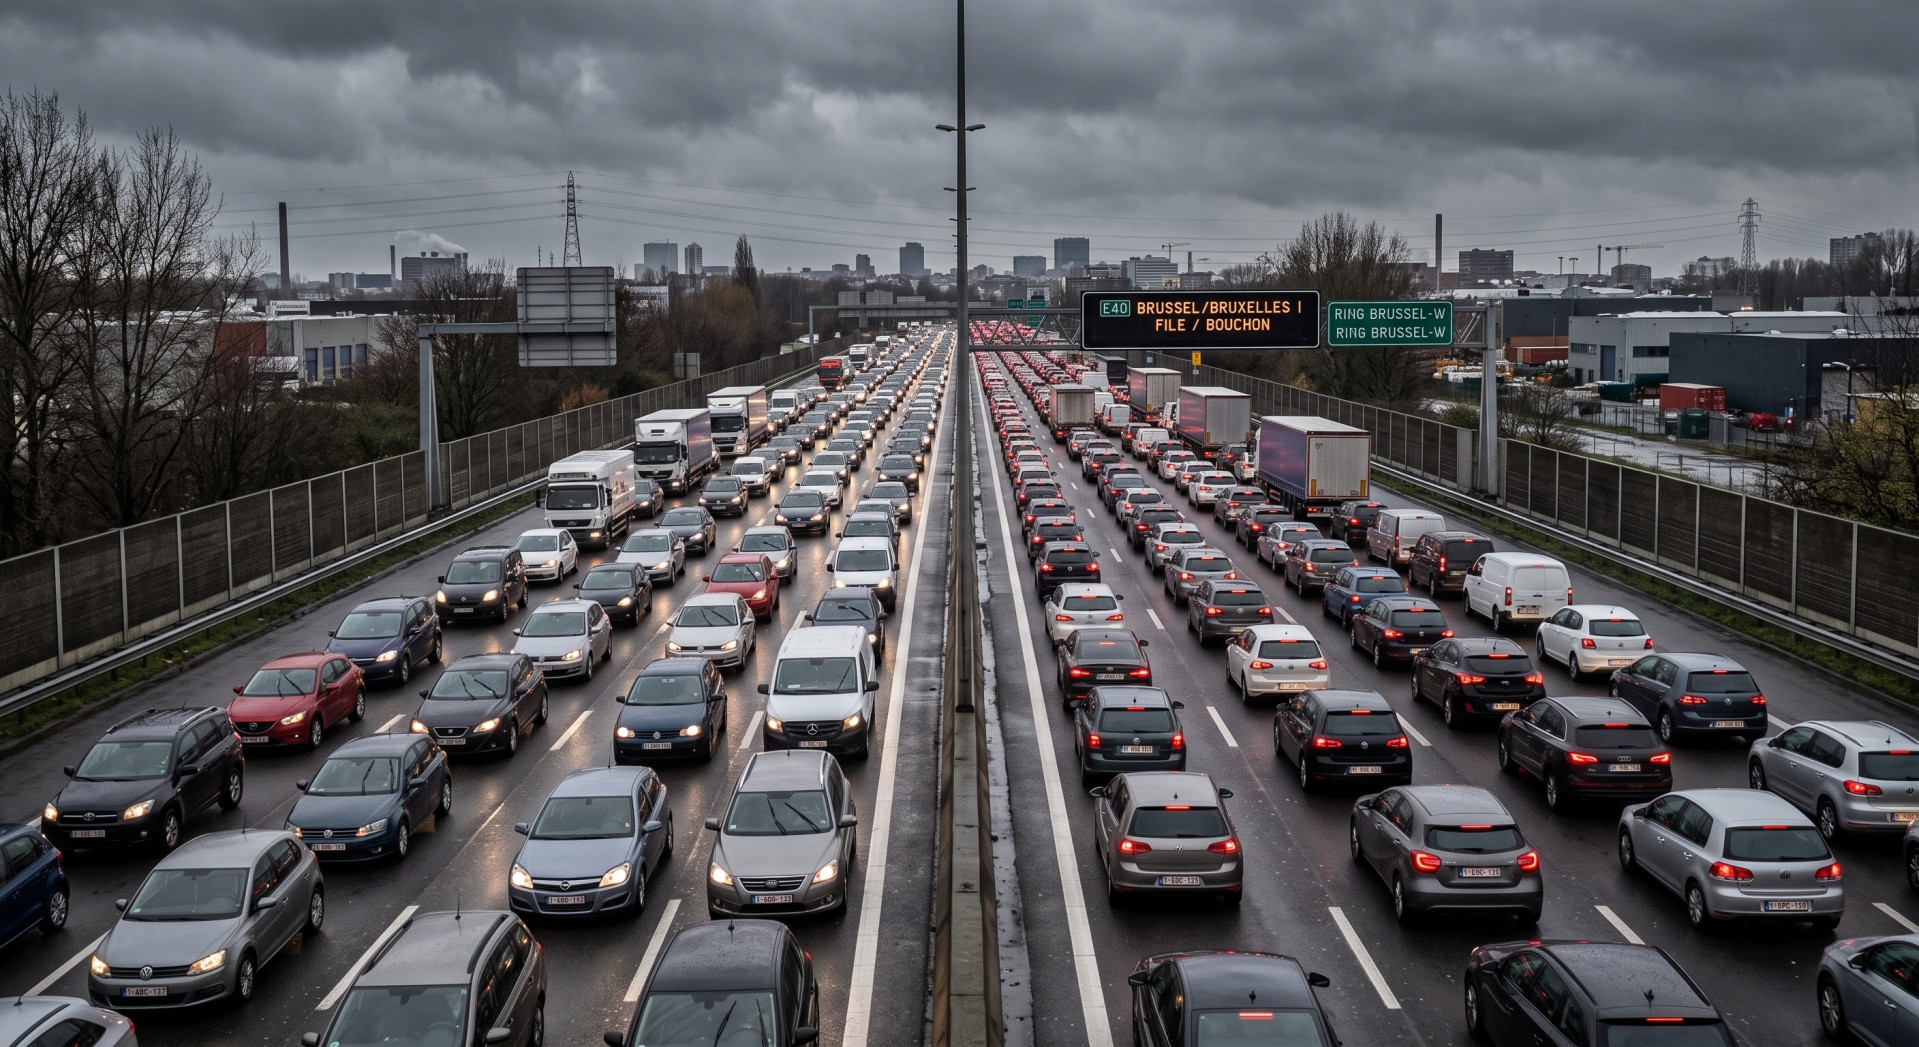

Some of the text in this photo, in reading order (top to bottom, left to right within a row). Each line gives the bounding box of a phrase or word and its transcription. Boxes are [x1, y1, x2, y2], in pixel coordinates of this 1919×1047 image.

[1103, 302, 1128, 314] E40
[1137, 301, 1291, 314] BRUSSEL/BRUXELLES
[1334, 307, 1446, 320] RING BRUSSEL-W
[1155, 318, 1270, 331] FILE / BOUCHON
[1336, 326, 1446, 339] RING BRUSSEL-W
